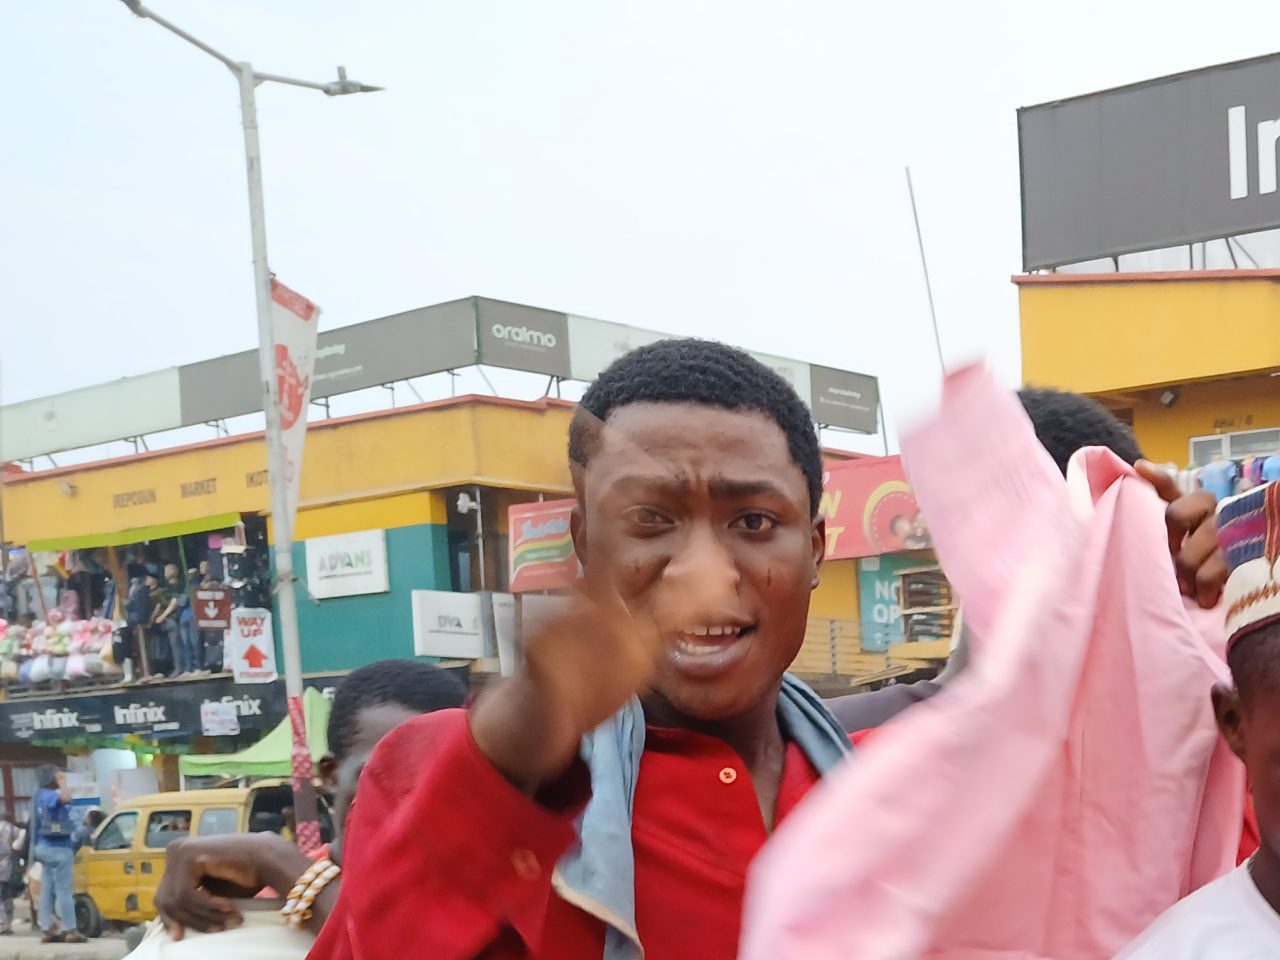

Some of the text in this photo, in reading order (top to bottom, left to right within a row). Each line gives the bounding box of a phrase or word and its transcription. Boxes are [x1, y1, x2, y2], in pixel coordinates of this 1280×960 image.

[492, 323, 557, 348] oraimo
[180, 477, 217, 498] MARKET
[32, 707, 79, 729] Infinix
[113, 701, 166, 725] Infinix
